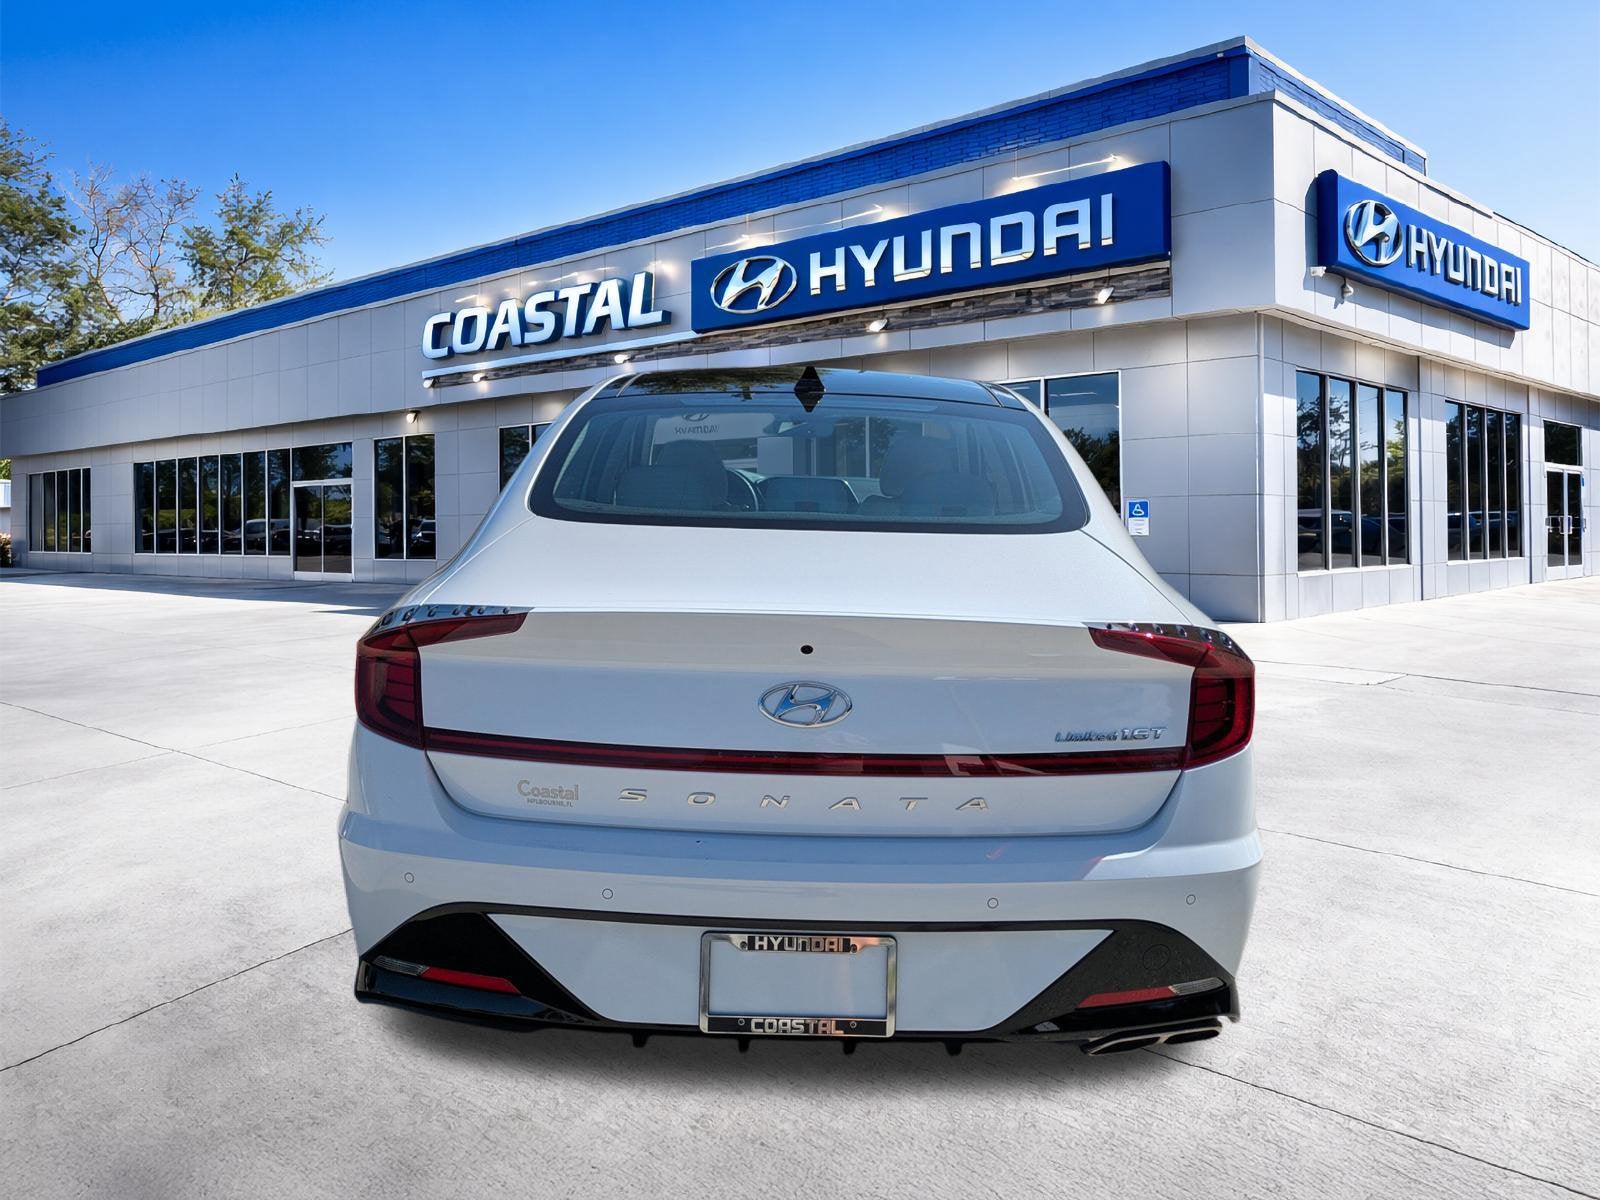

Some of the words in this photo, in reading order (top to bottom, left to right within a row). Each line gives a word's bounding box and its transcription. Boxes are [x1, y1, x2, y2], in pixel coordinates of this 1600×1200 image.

[809, 193, 1113, 296] HYUNDAI
[1406, 224, 1522, 306] HYUNDAI
[422, 271, 669, 359] COASTAL
[517, 779, 579, 801] Coastal
[618, 788, 989, 811] SONATA
[754, 935, 844, 953] HYUNDAI
[750, 1018, 844, 1035] COASTAL
